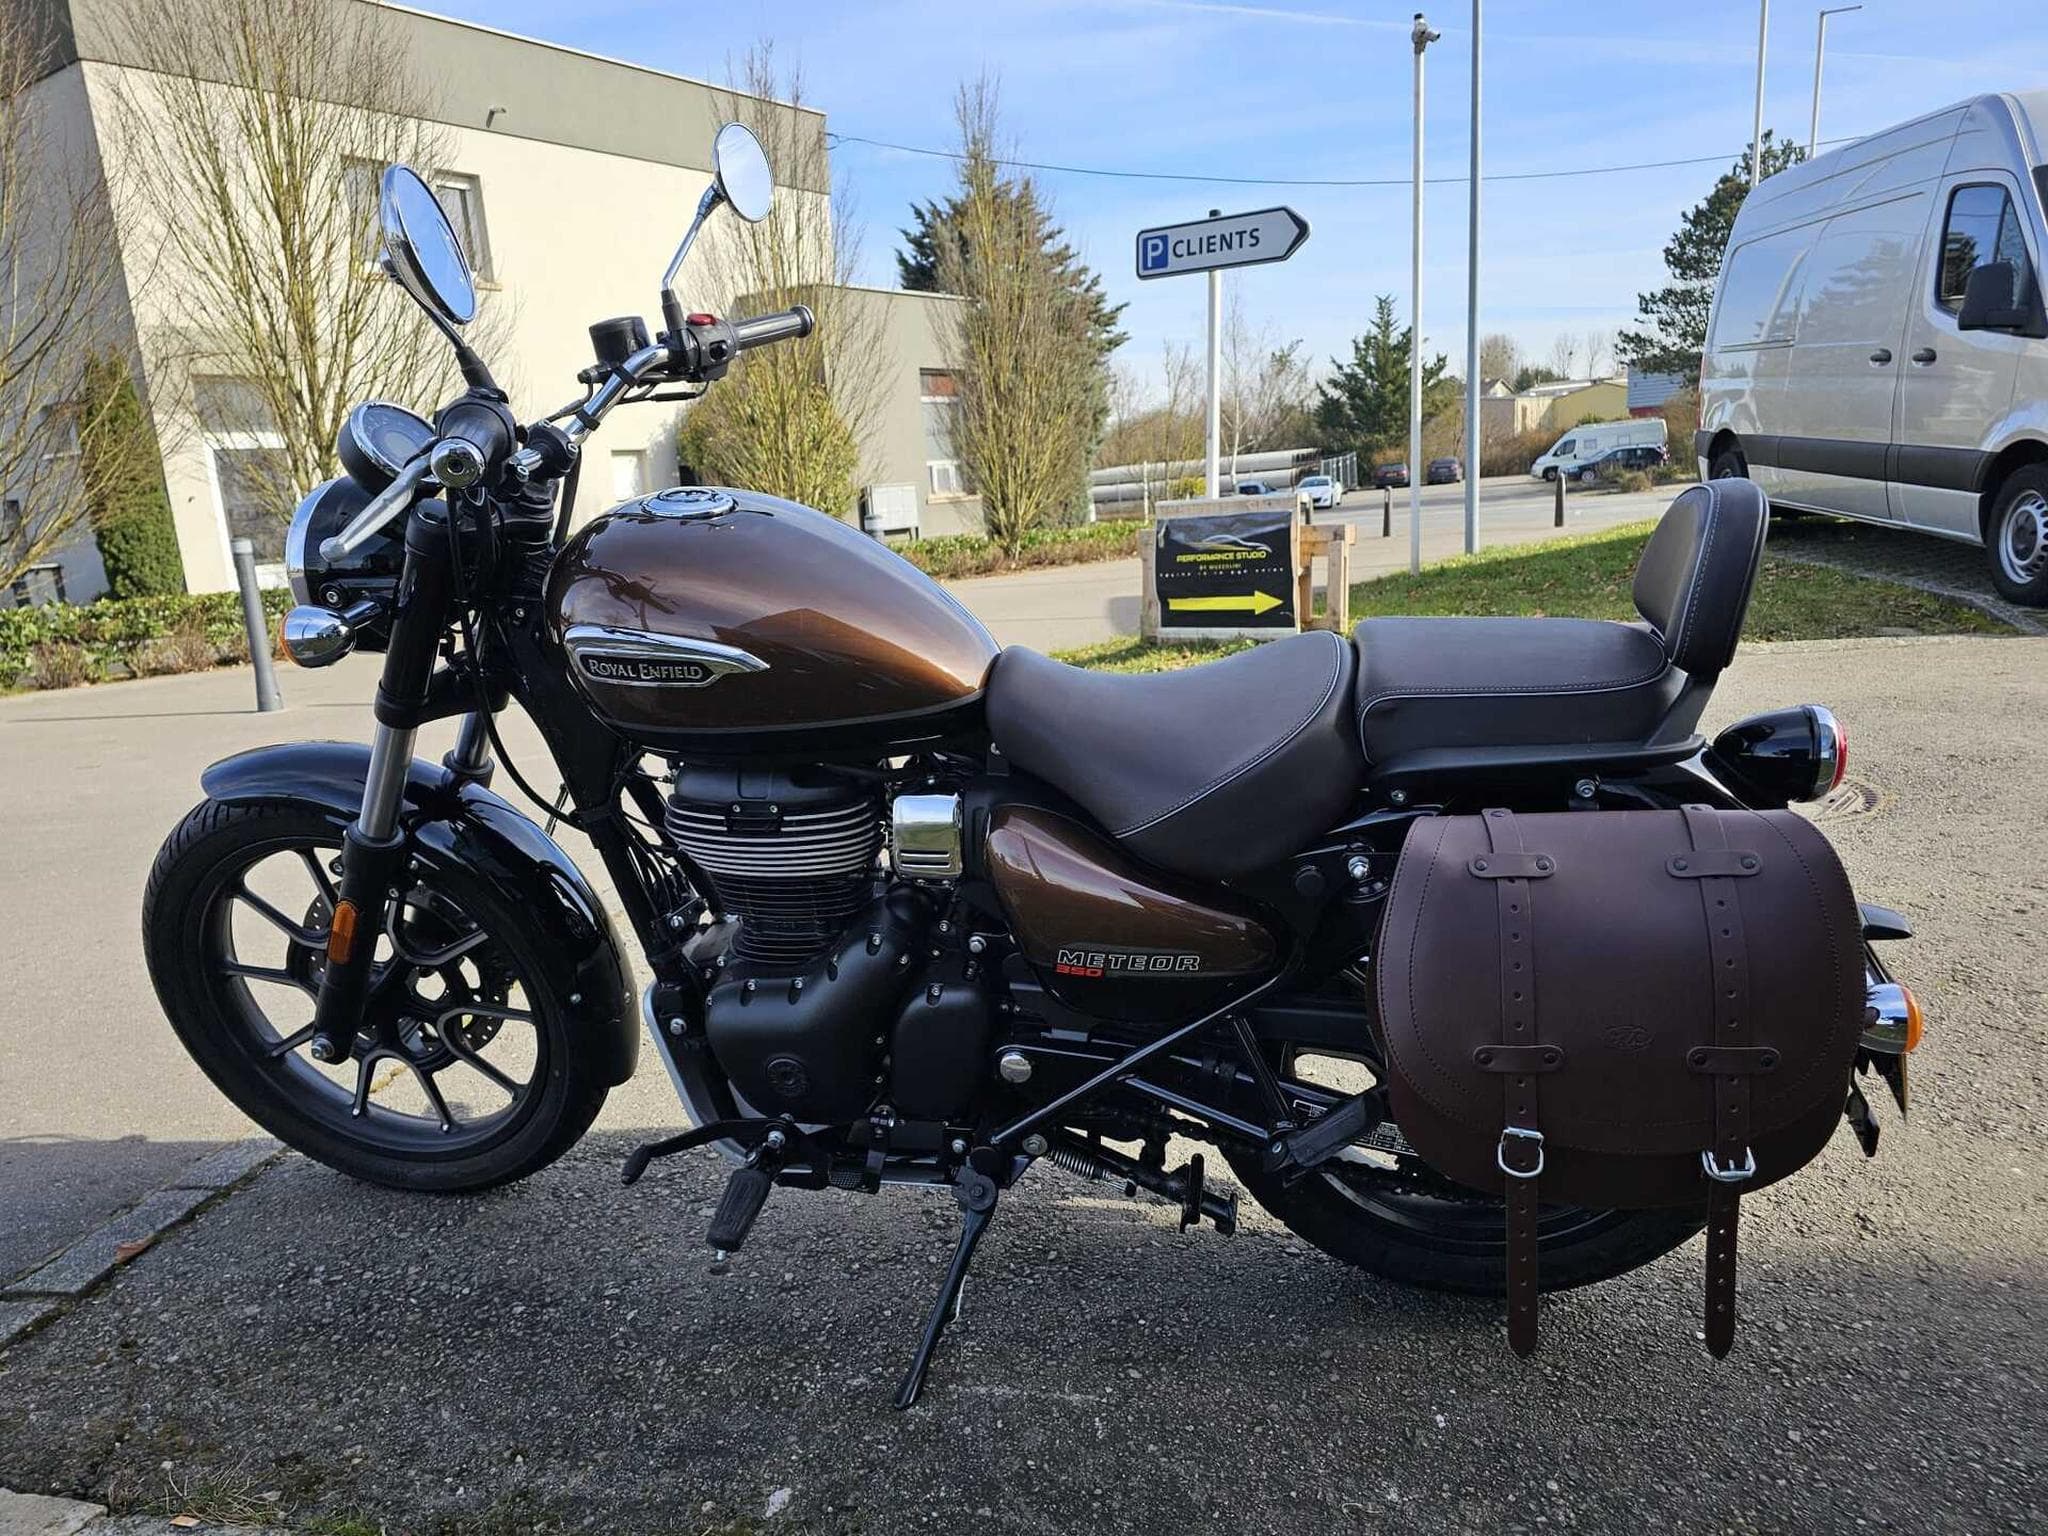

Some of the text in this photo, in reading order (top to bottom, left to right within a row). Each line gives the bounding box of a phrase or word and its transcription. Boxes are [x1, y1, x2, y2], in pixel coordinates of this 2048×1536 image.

[1147, 228, 1260, 268] P CLIENTS
[1176, 550, 1266, 563] PERFORMANCE STUDIO
[1057, 950, 1200, 972] METEOR
[1055, 964, 1103, 977] 350
